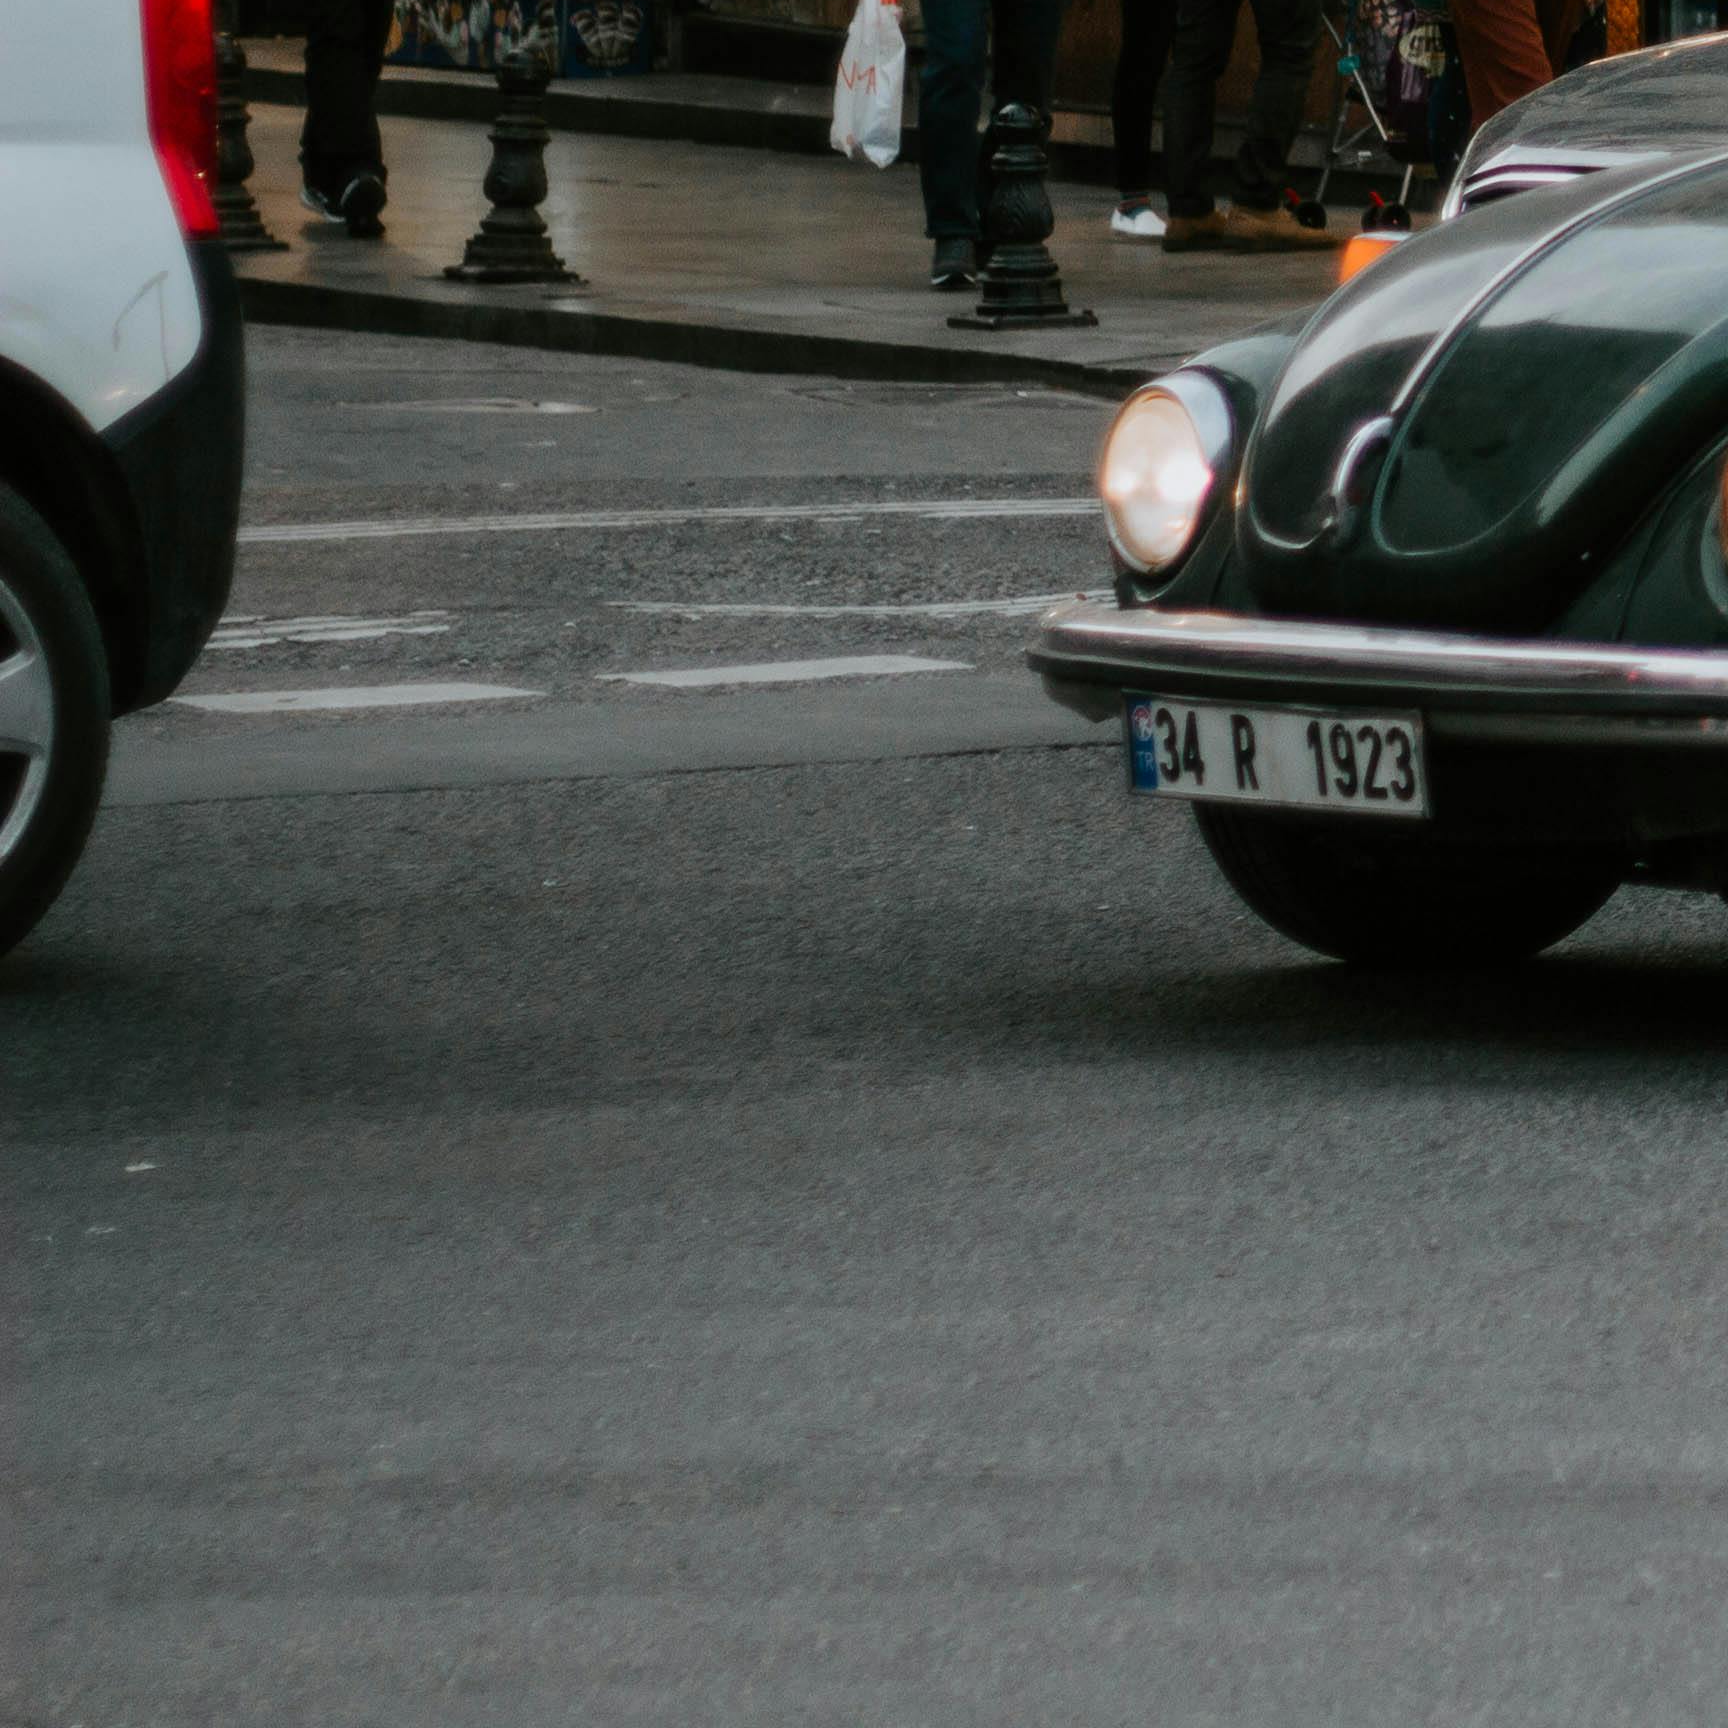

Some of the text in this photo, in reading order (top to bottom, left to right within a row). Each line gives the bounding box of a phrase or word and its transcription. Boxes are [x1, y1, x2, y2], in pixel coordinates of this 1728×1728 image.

[1155, 708, 1205, 787] 34
[1230, 713, 1260, 791] R
[1307, 719, 1415, 802] 1923
